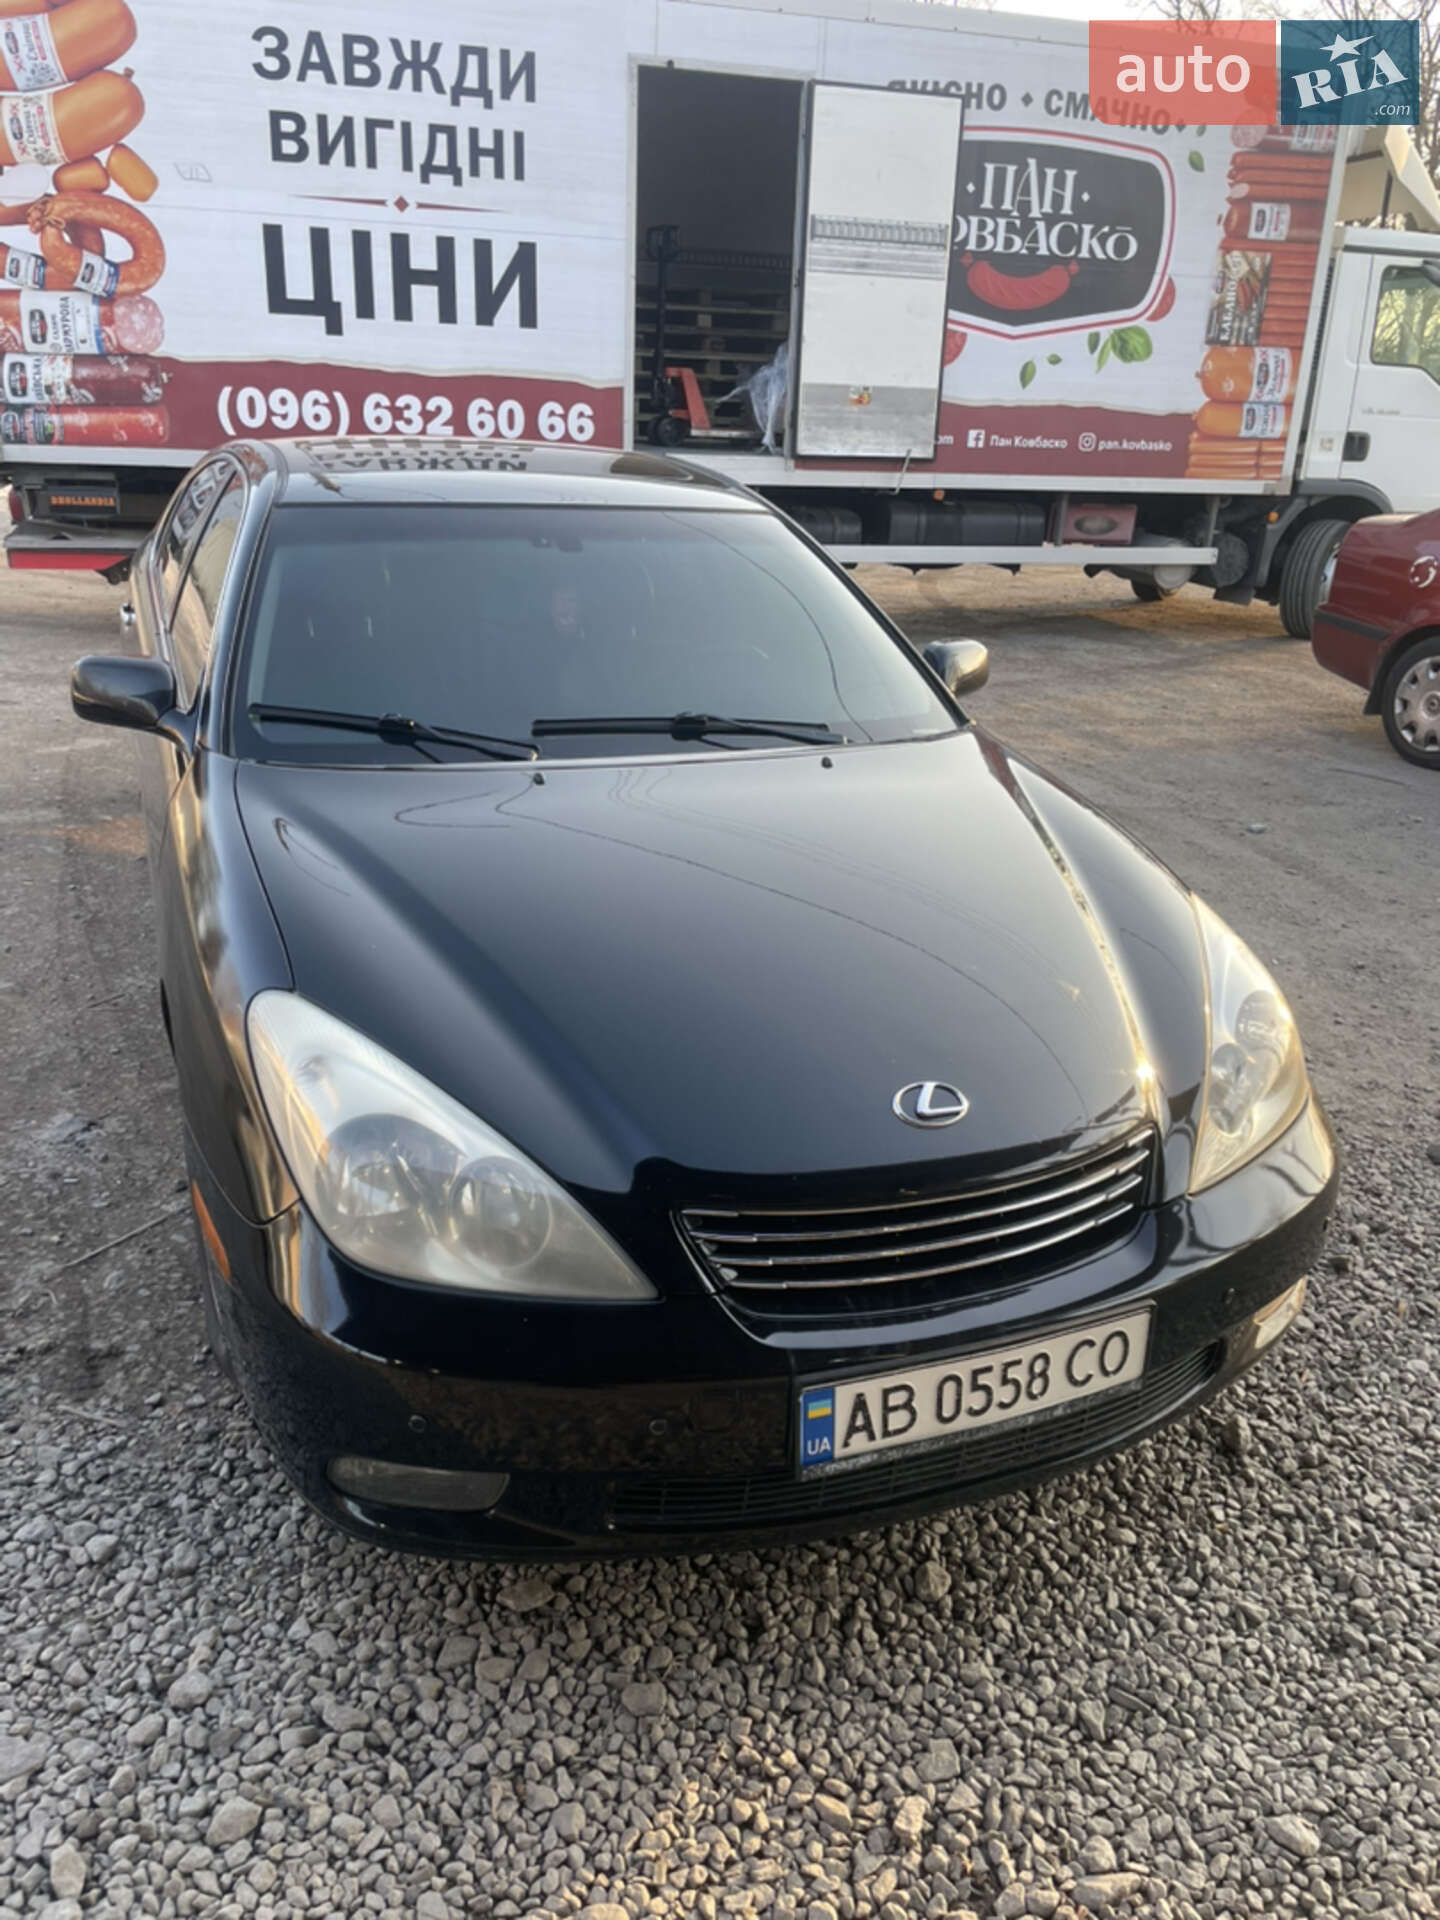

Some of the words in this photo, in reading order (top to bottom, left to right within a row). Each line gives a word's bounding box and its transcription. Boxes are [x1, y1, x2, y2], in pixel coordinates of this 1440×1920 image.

[251, 26, 537, 109] ЗАВЖДИ
[1044, 89, 1171, 135] СМАЧНО
[268, 109, 525, 186] ВИГІДНІ
[979, 157, 1078, 218] ПАН
[262, 223, 538, 336] ЦІНИ
[218, 386, 350, 436] (096)
[363, 393, 454, 435] 632
[467, 398, 525, 439] 60
[538, 401, 595, 442] 66
[841, 1384, 918, 1449] AB
[935, 1352, 1051, 1424] 0558
[1065, 1330, 1130, 1387] CO
[807, 1436, 831, 1456] UA
